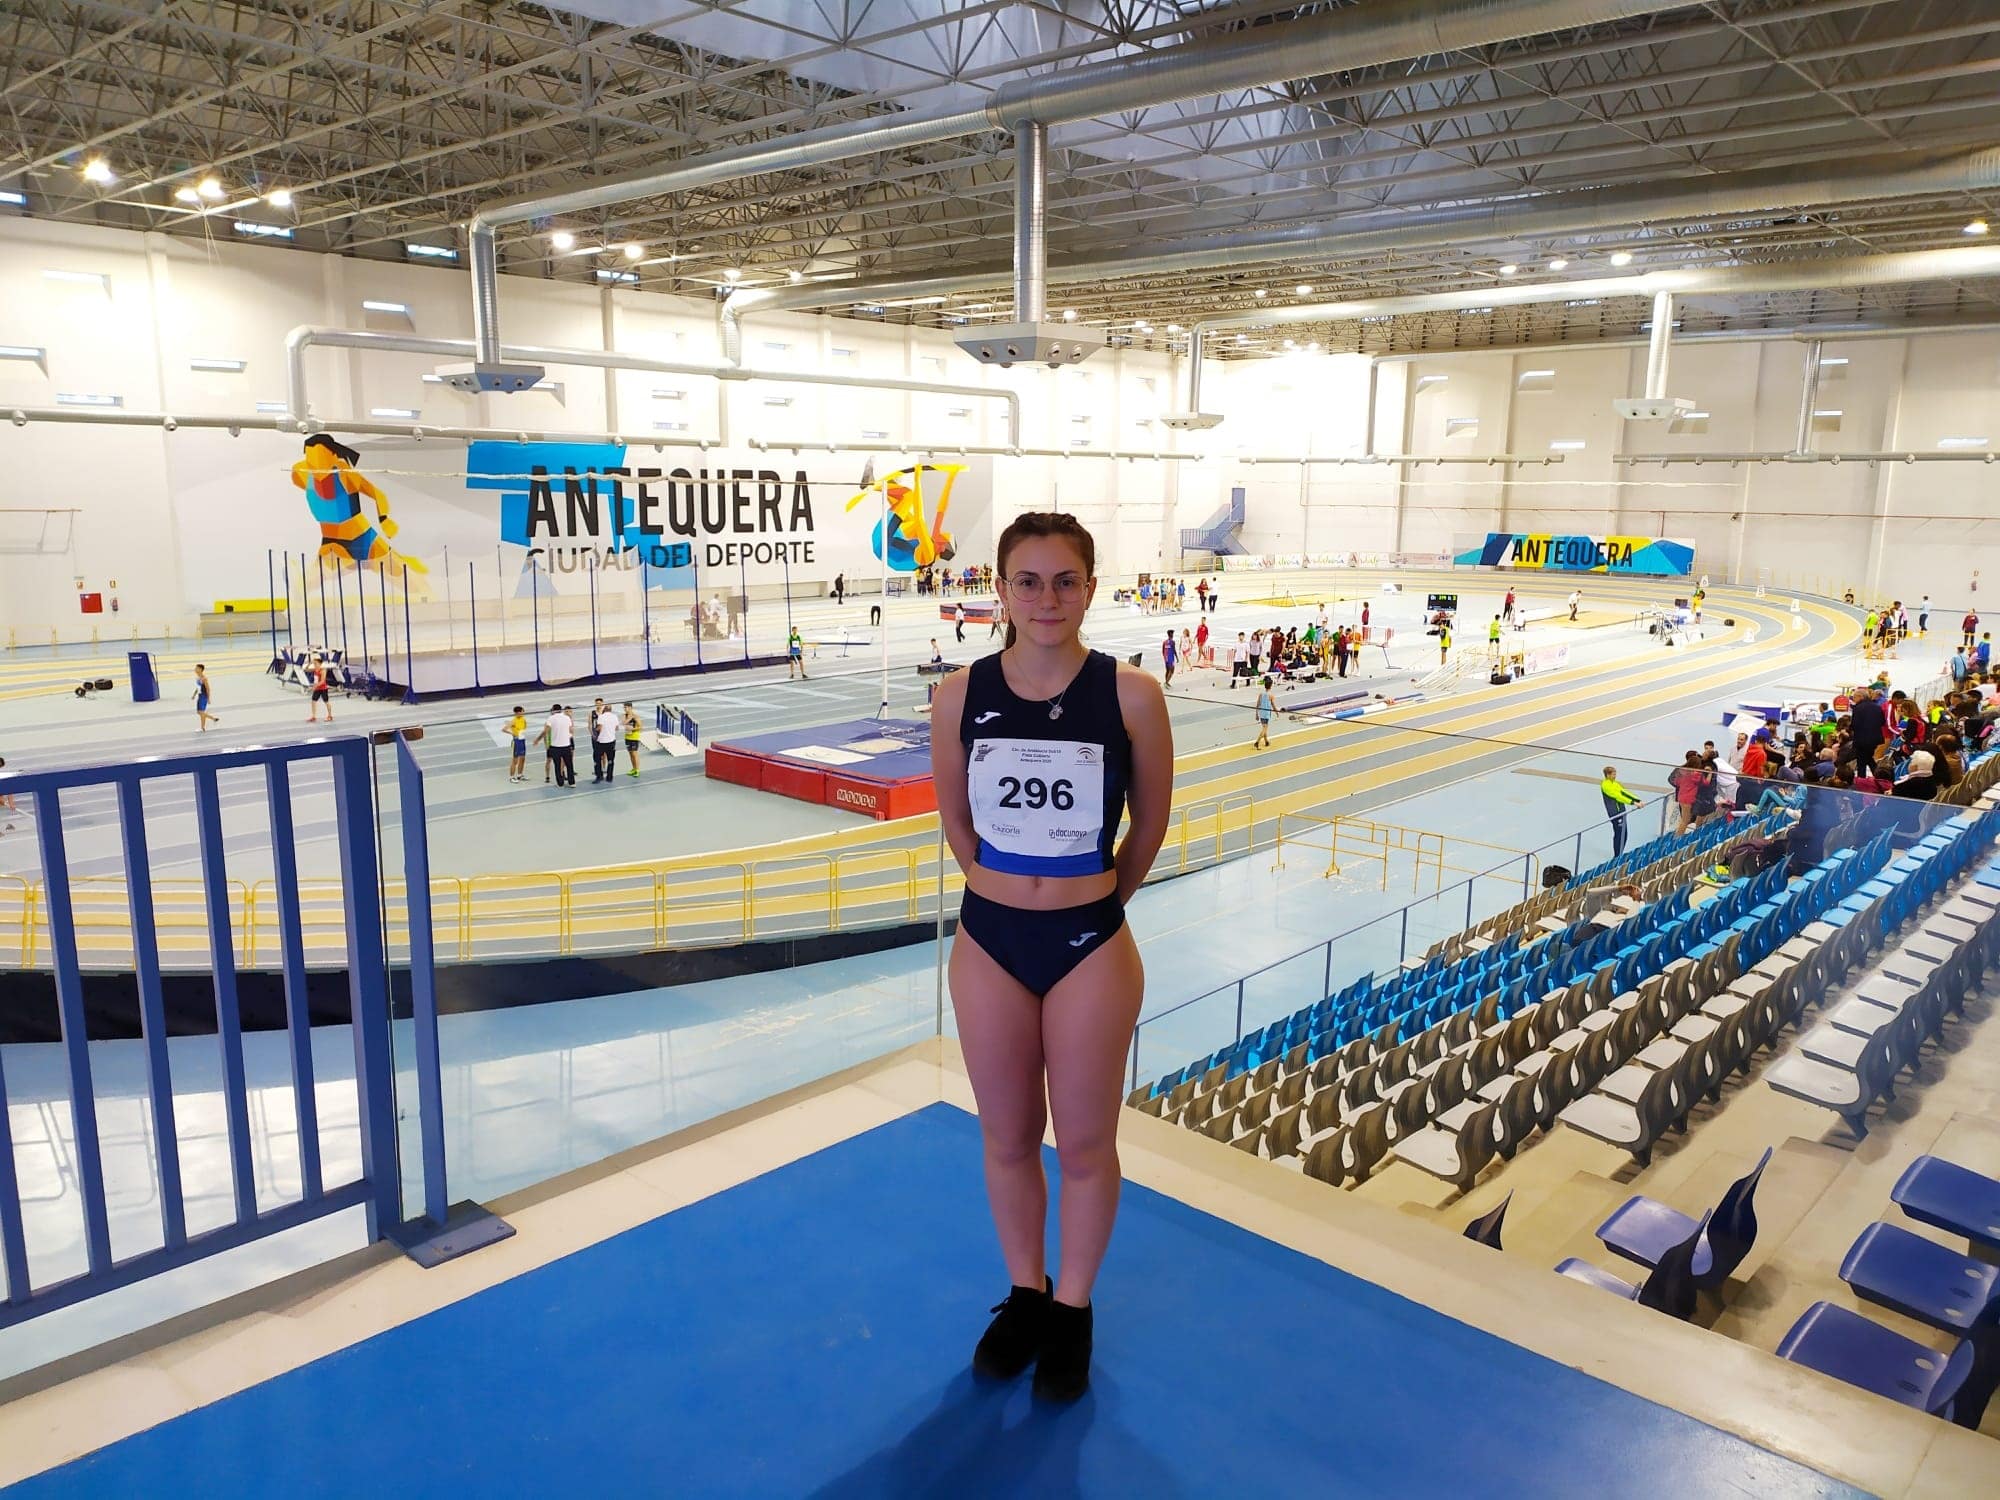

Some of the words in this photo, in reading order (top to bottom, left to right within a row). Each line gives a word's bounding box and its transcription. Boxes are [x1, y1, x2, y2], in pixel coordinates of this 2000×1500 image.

[526, 465, 815, 538] ANTEQUERA
[706, 541, 815, 567] DEPORTE
[1511, 537, 1634, 569] ANTEQUERA
[836, 788, 877, 808] MONDO
[998, 776, 1074, 810] 296
[1055, 828, 1088, 838] docunova
